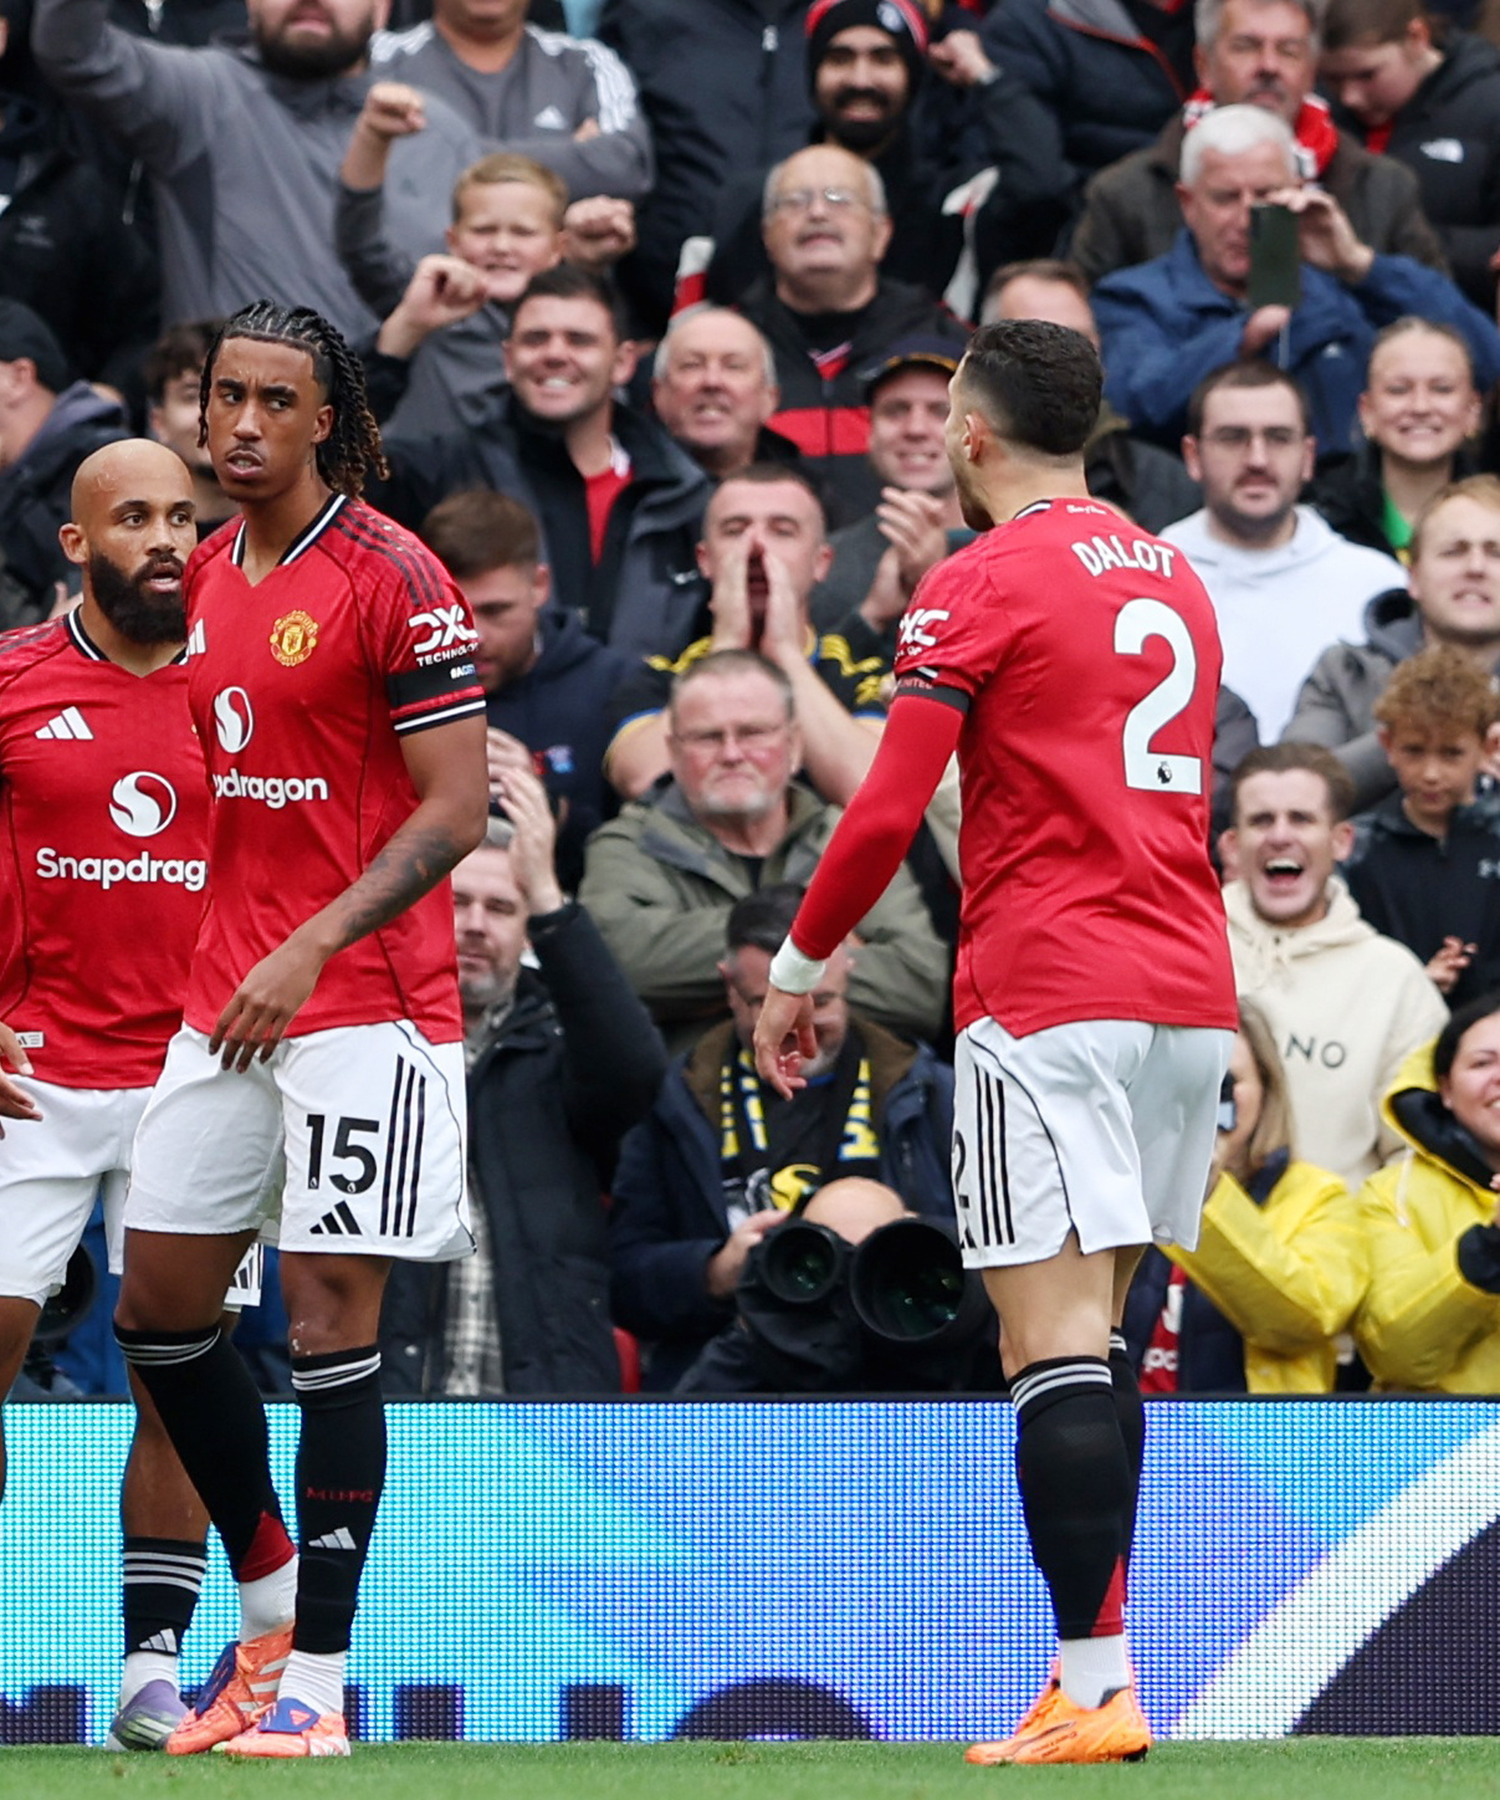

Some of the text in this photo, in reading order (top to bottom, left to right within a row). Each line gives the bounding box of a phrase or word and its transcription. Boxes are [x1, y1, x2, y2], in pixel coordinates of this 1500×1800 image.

[1071, 535, 1174, 578] DALOT
[408, 604, 479, 654] DXC
[899, 608, 951, 647] XC
[1113, 597, 1202, 795] 2
[213, 768, 329, 809] pdragon
[36, 847, 207, 892] Snapdrag
[306, 1113, 380, 1195] 15
